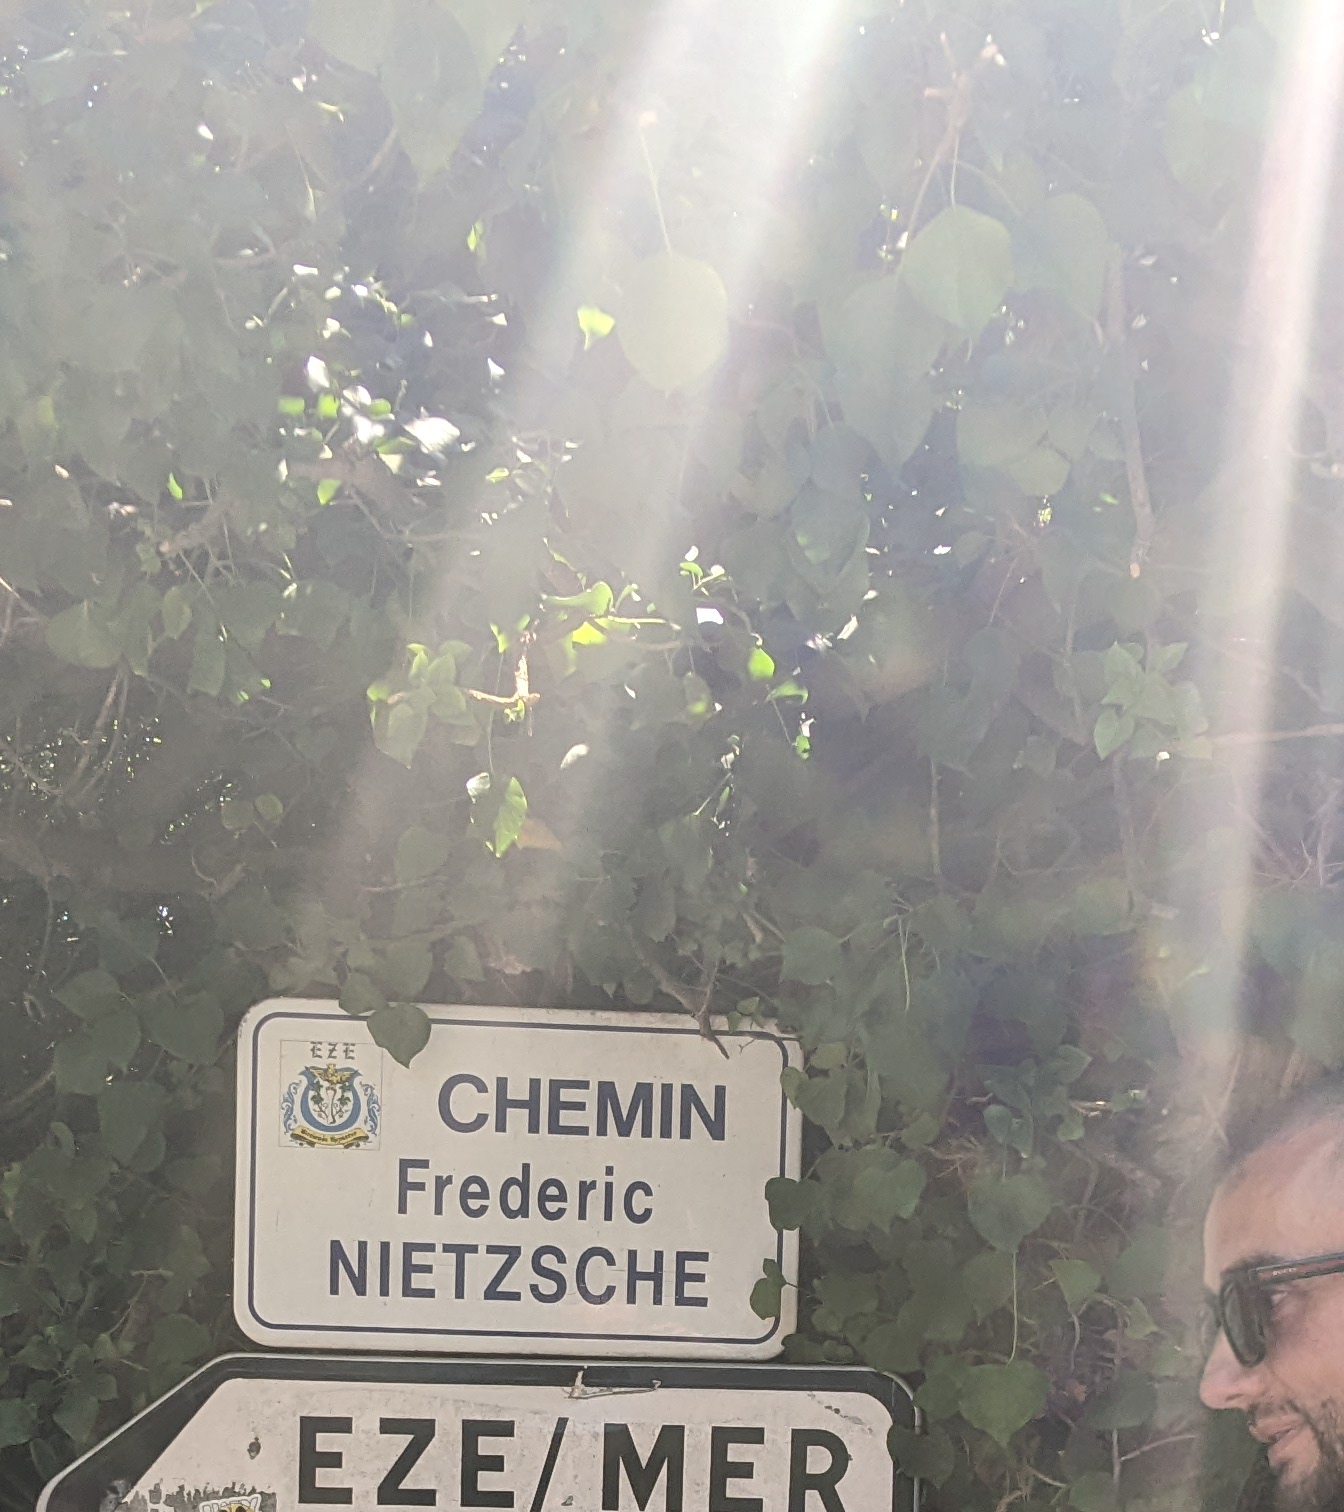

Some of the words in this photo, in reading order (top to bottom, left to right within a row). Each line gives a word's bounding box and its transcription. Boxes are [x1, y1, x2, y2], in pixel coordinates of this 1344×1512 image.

[310, 1041, 356, 1060] EZE
[439, 1074, 727, 1141] CHEMIN
[397, 1159, 654, 1224] Frederic
[329, 1240, 710, 1308] NIETZSCHE
